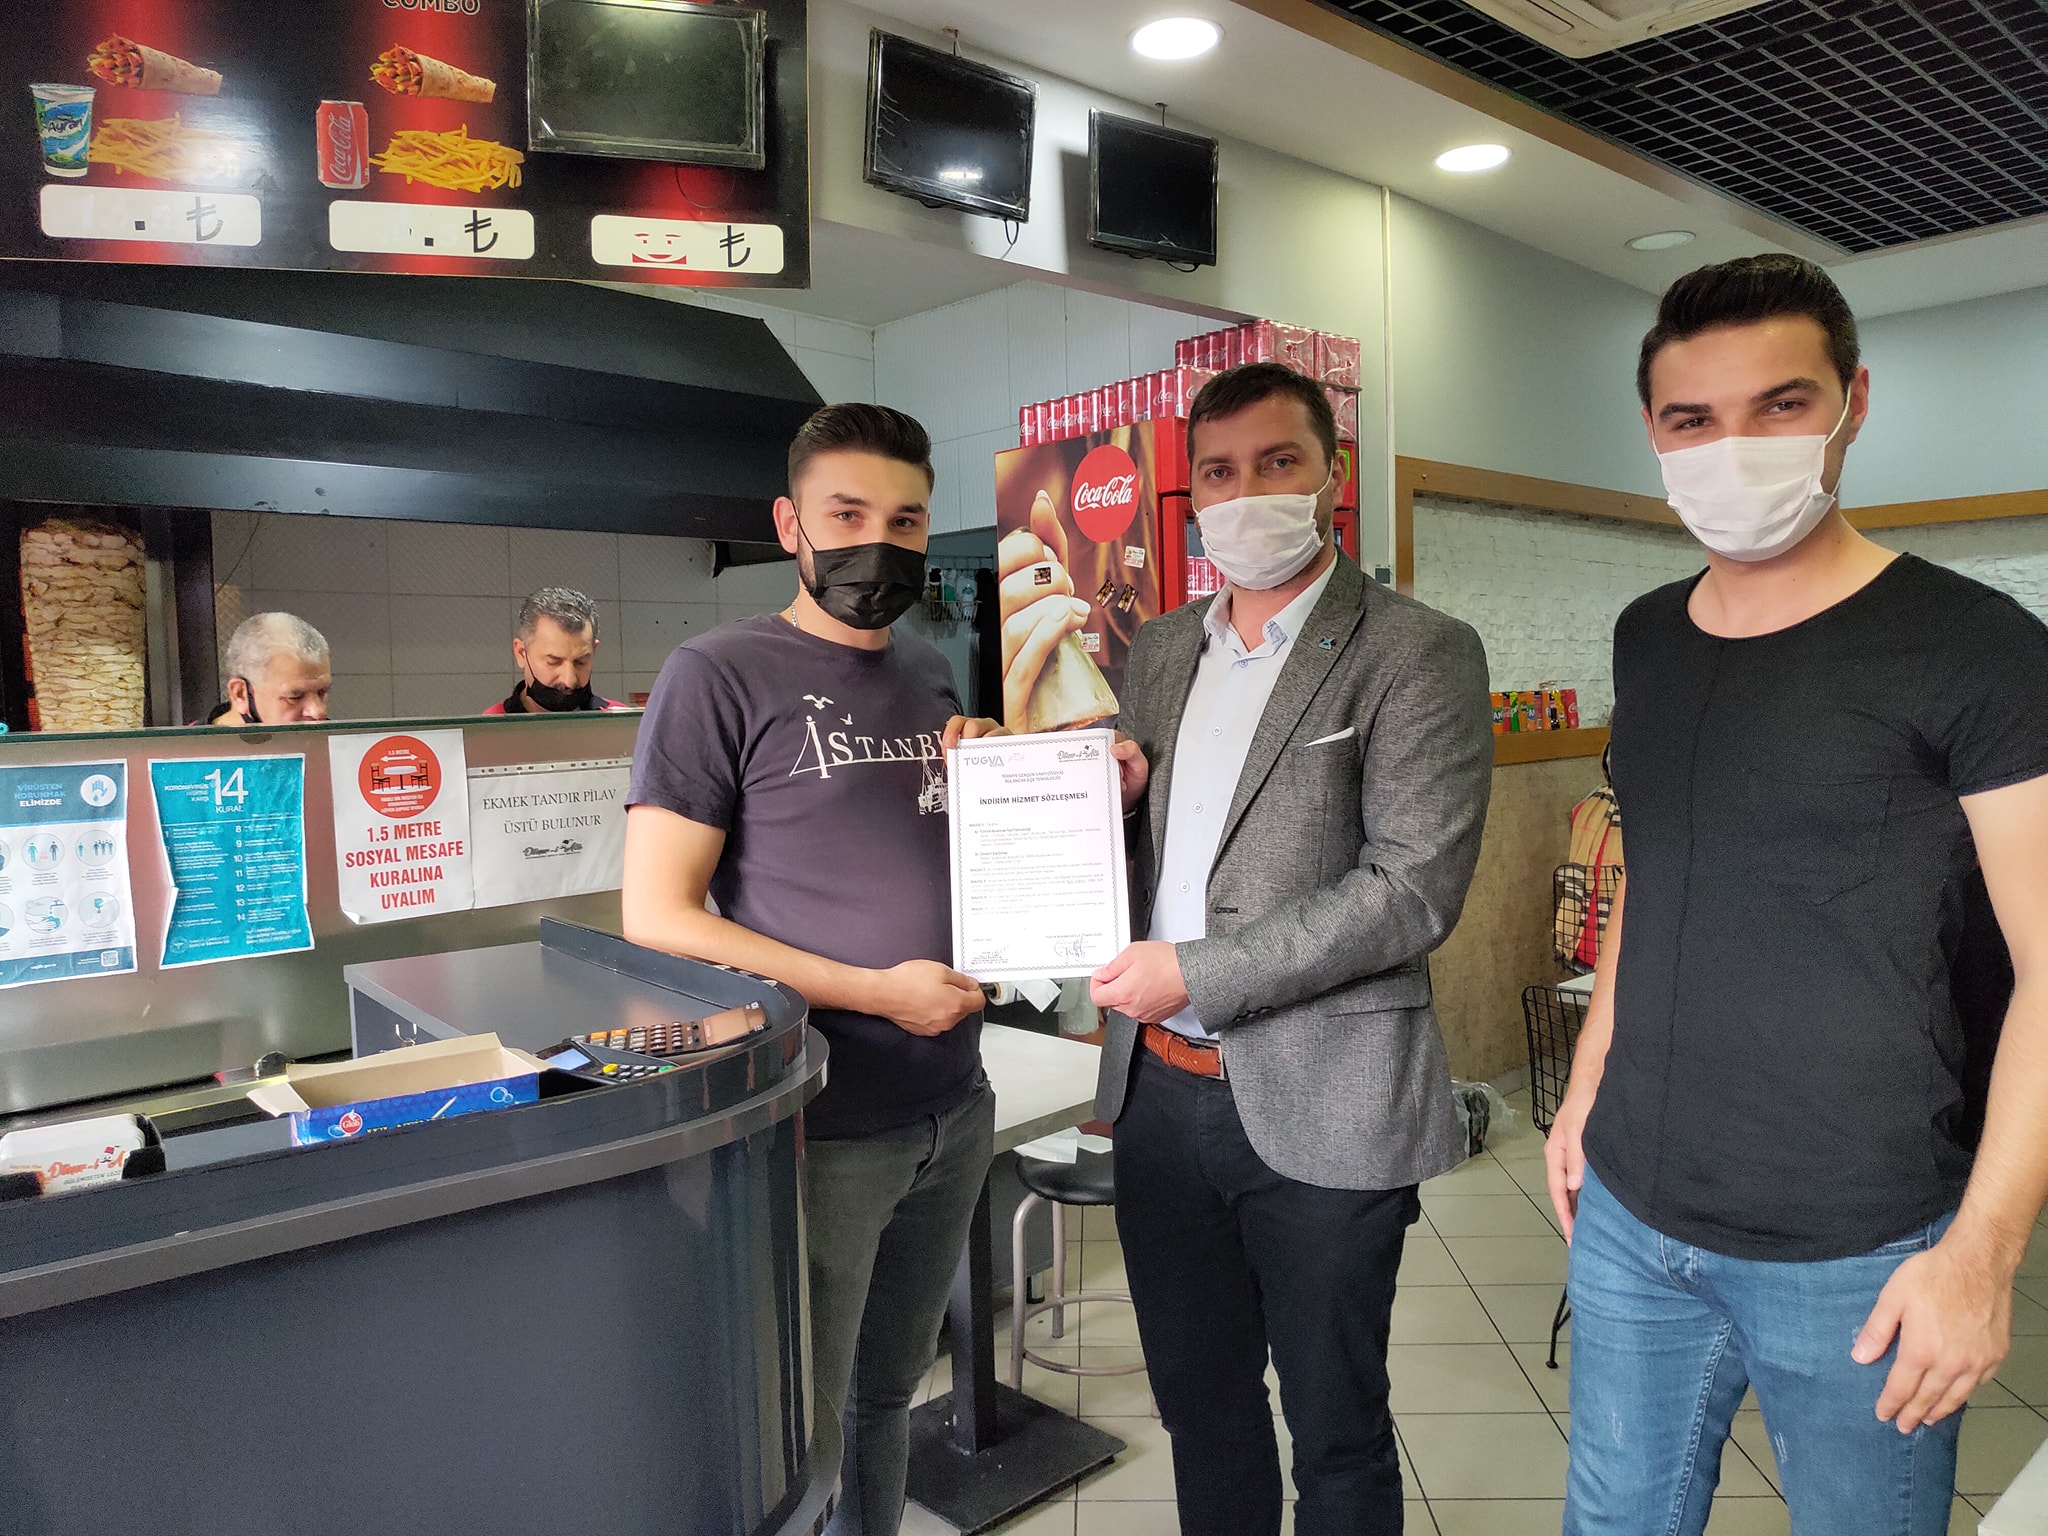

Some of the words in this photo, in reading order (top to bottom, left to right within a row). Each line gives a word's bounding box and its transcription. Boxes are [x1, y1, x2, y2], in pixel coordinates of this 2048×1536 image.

[1074, 474, 1136, 512] Coca-Cola
[789, 715, 944, 779] İSTANB
[14, 790, 66, 800] KORUNMAK
[204, 767, 249, 806] 14
[979, 796, 1010, 805] İNDİRİM
[1011, 794, 1040, 804] HİZMET
[1040, 791, 1089, 801] SÖZLEŞMESİ
[19, 798, 62, 807] ELİMİZDE
[215, 805, 244, 814] KURAL
[482, 794, 529, 811] EKMEK
[531, 791, 581, 807] TANDIR
[583, 788, 617, 803] PİLAV
[367, 825, 389, 843] 1.5
[394, 820, 442, 841] METRE
[503, 819, 539, 835] ÜSTÜ
[541, 814, 602, 831] BULUNUR
[345, 845, 402, 868] SOSYAL
[405, 840, 464, 861] MESAFE
[369, 865, 444, 888] KURALINA
[381, 888, 435, 910] UYALIM
